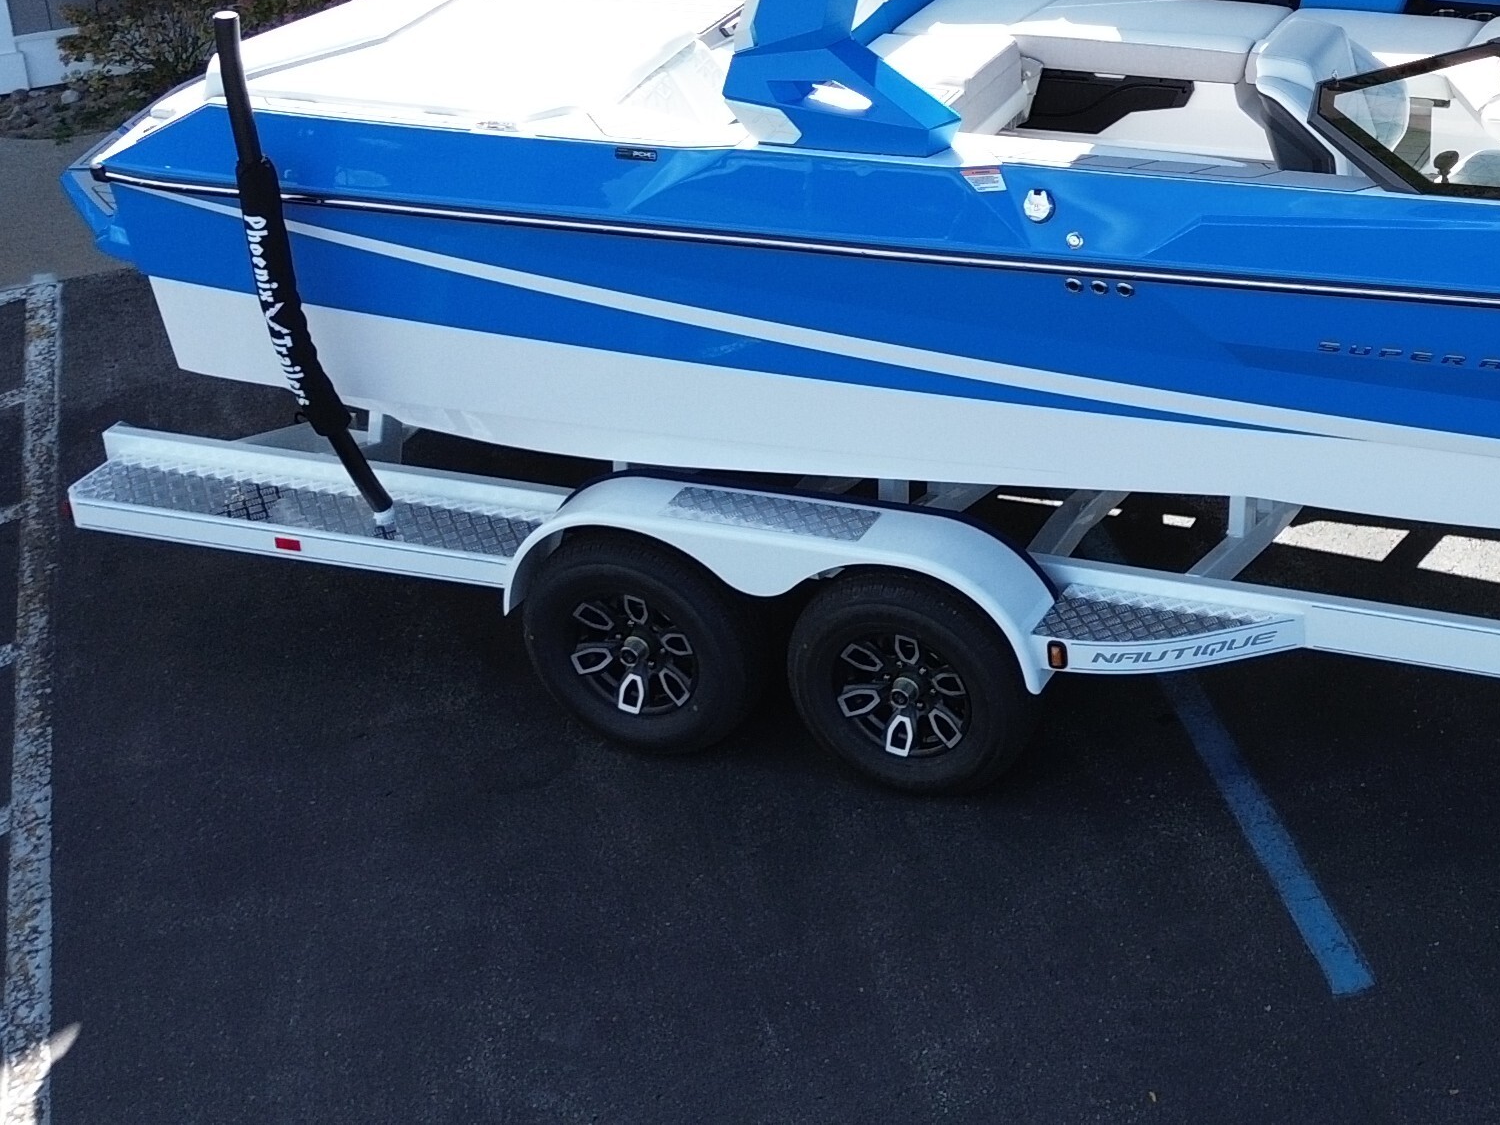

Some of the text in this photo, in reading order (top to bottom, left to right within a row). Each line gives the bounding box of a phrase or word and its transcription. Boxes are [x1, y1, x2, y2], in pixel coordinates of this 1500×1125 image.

[243, 215, 279, 303] Phoenix
[271, 335, 310, 406] Trailers
[1317, 341, 1467, 366] SUPER
[1091, 630, 1278, 664] NAUTIQUE
